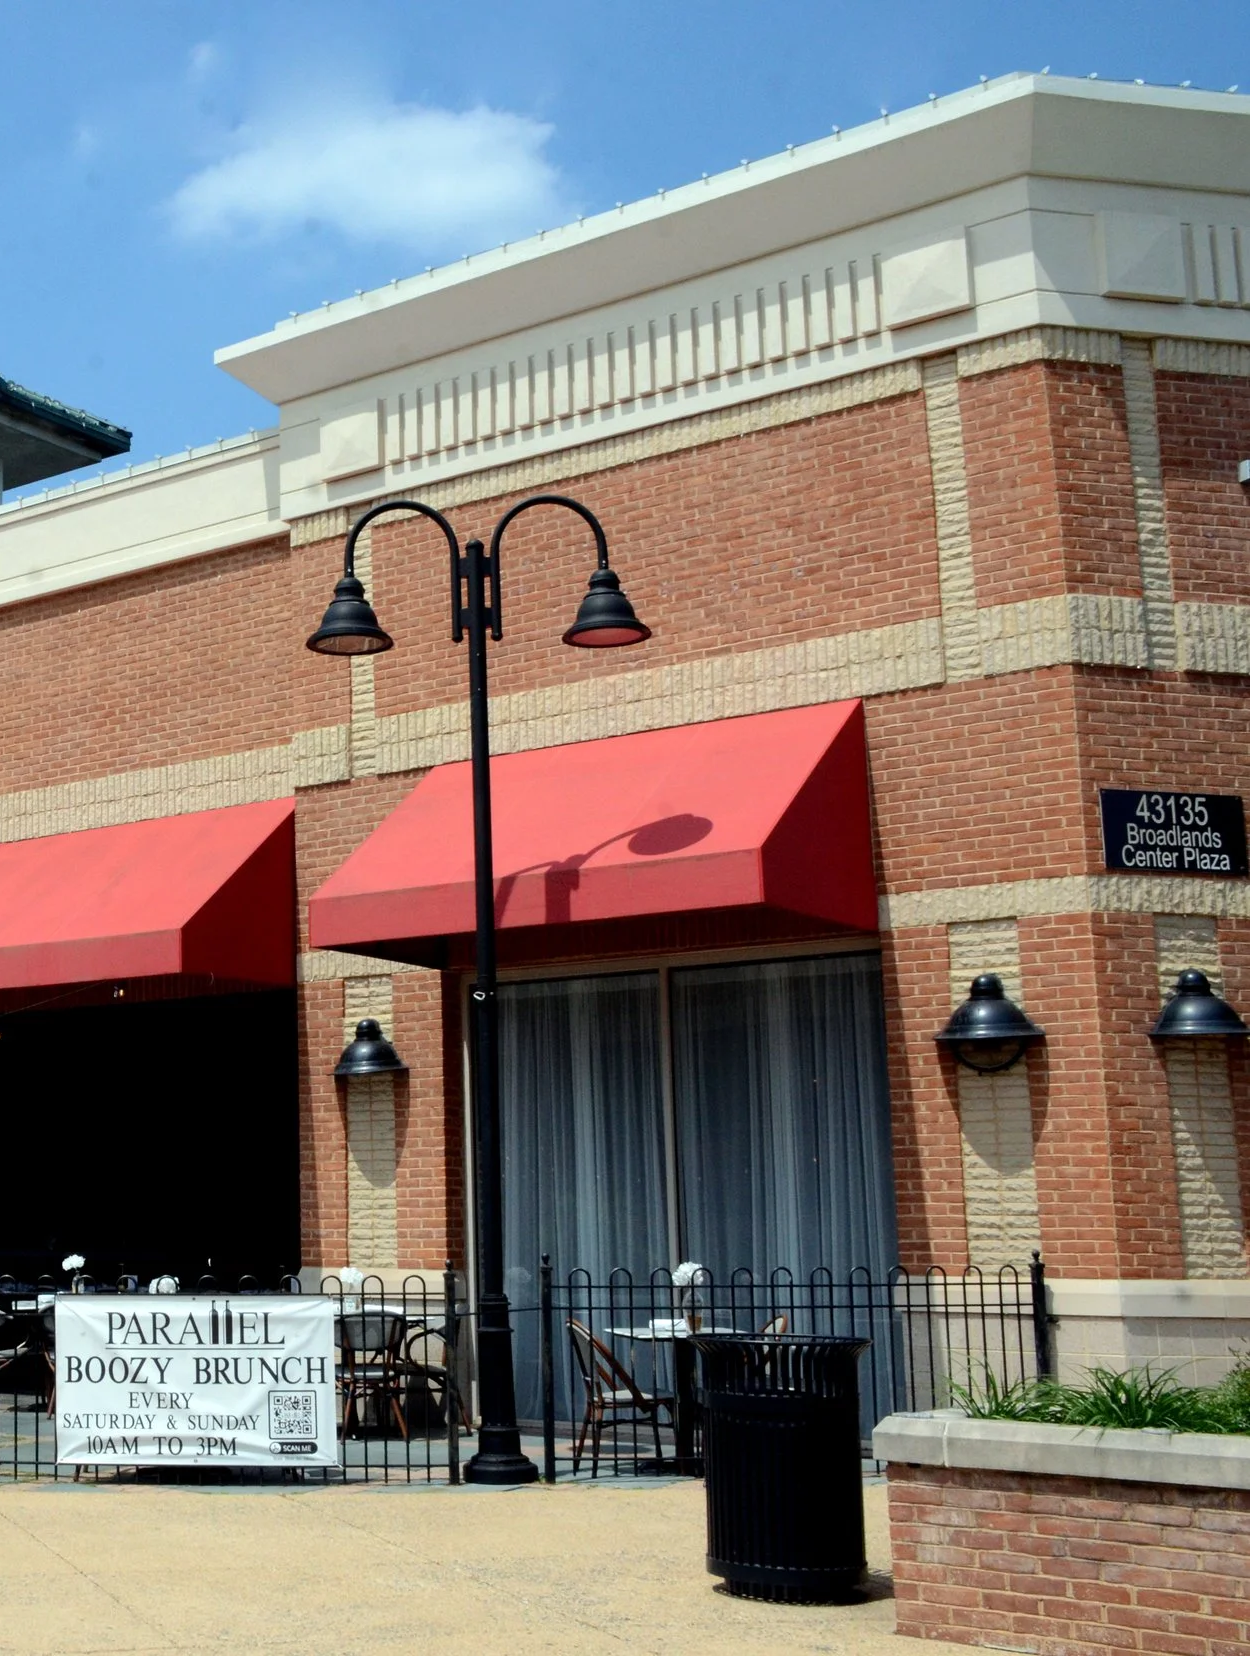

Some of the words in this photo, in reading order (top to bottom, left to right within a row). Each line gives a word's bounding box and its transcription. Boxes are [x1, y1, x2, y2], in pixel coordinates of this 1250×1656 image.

[1136, 794, 1208, 826] 43135
[1126, 823, 1222, 848] Broadlands
[1121, 845, 1178, 868] Center
[1183, 847, 1230, 870] Plaza
[65, 1355, 174, 1384] BOOZY
[193, 1356, 328, 1385] BRUNCH
[129, 1392, 194, 1409] EVERY
[63, 1413, 156, 1430] SATURDAY
[167, 1415, 178, 1430] &
[187, 1414, 260, 1431] SUNDAY
[86, 1435, 139, 1455] 10AM
[153, 1436, 183, 1455] TO
[196, 1436, 238, 1456] 3PM
[282, 1444, 301, 1452] SCAN
